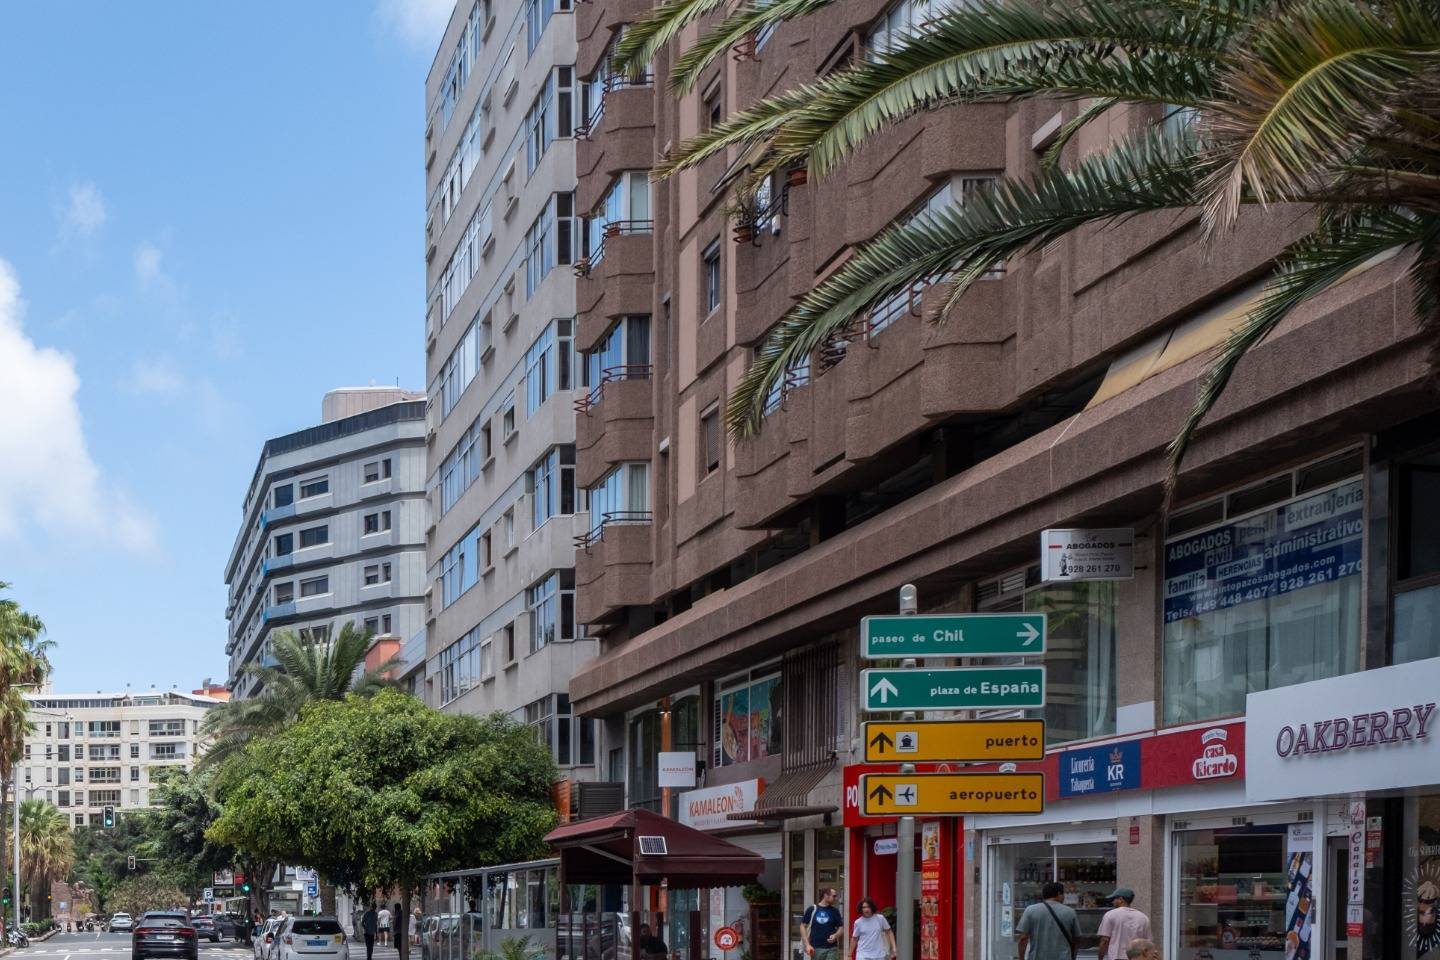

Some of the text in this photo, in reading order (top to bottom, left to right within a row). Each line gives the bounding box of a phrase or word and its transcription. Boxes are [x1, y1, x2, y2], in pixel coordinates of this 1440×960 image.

[1287, 487, 1363, 524] extranjería
[1168, 529, 1231, 562] ABOGADOS
[1264, 519, 1363, 559] administrativo
[1206, 548, 1233, 567] civil
[1218, 557, 1262, 578] HERENCIAS
[1068, 565, 1084, 573] 928
[1167, 572, 1206, 595] familia
[1279, 577, 1304, 592] 928
[1309, 569, 1333, 584] 261
[872, 629, 964, 645] paseo de Chil
[930, 681, 1040, 697] plaza de España
[1276, 702, 1436, 758] OAKBERRY
[985, 734, 1038, 749] puerto
[1205, 745, 1225, 760] casa
[1107, 764, 1124, 781] KR
[1195, 758, 1236, 778] Ricardo
[949, 787, 1037, 802] aeropuerto
[689, 795, 734, 817] KAMALEON
